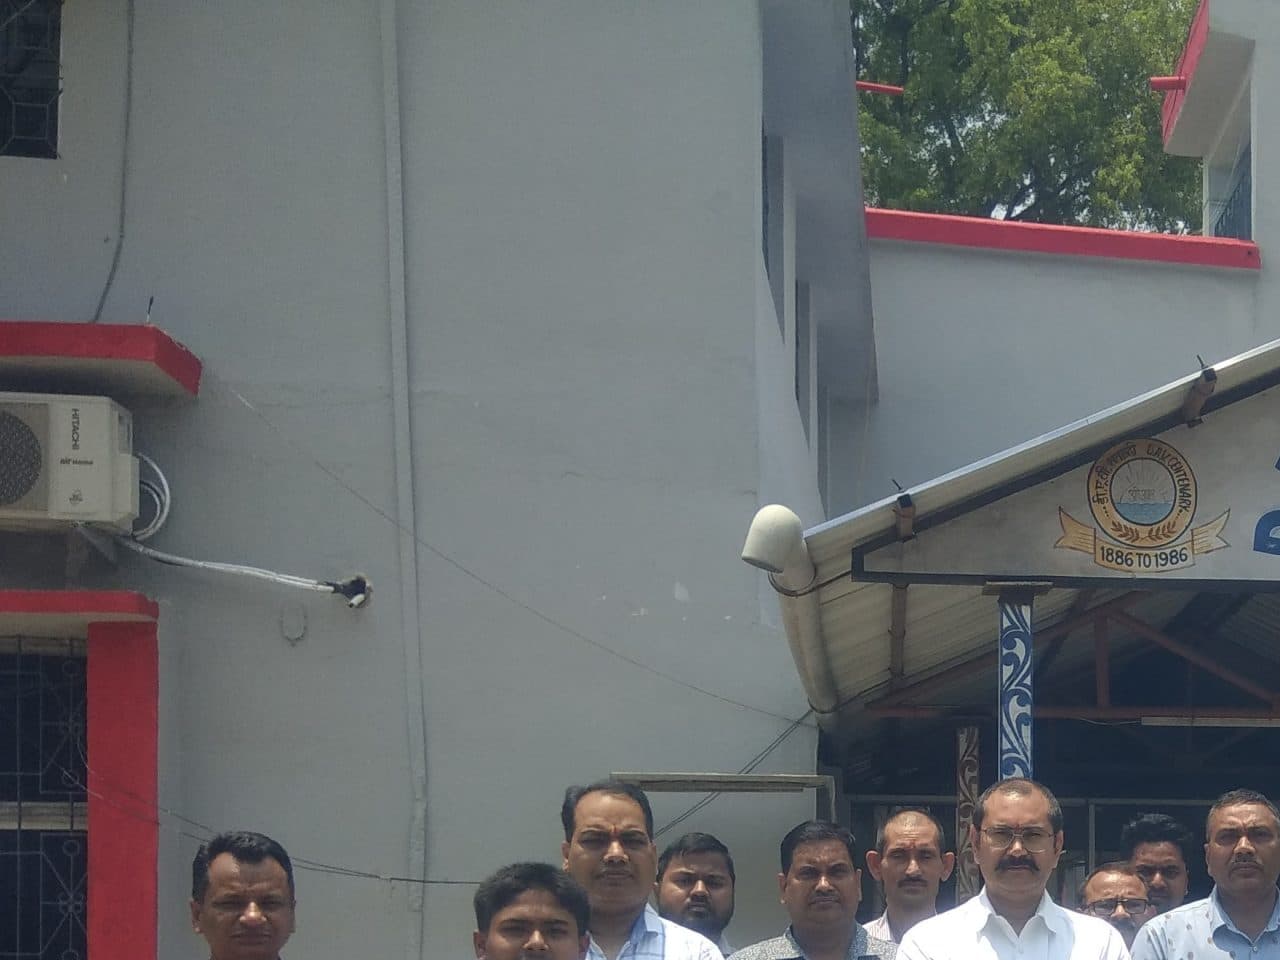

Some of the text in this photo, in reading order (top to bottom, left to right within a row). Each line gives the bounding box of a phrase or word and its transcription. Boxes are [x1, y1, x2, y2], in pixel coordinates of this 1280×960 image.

[71, 408, 80, 450] HITACHI
[1101, 546, 1189, 569] 1886 TO 1986
